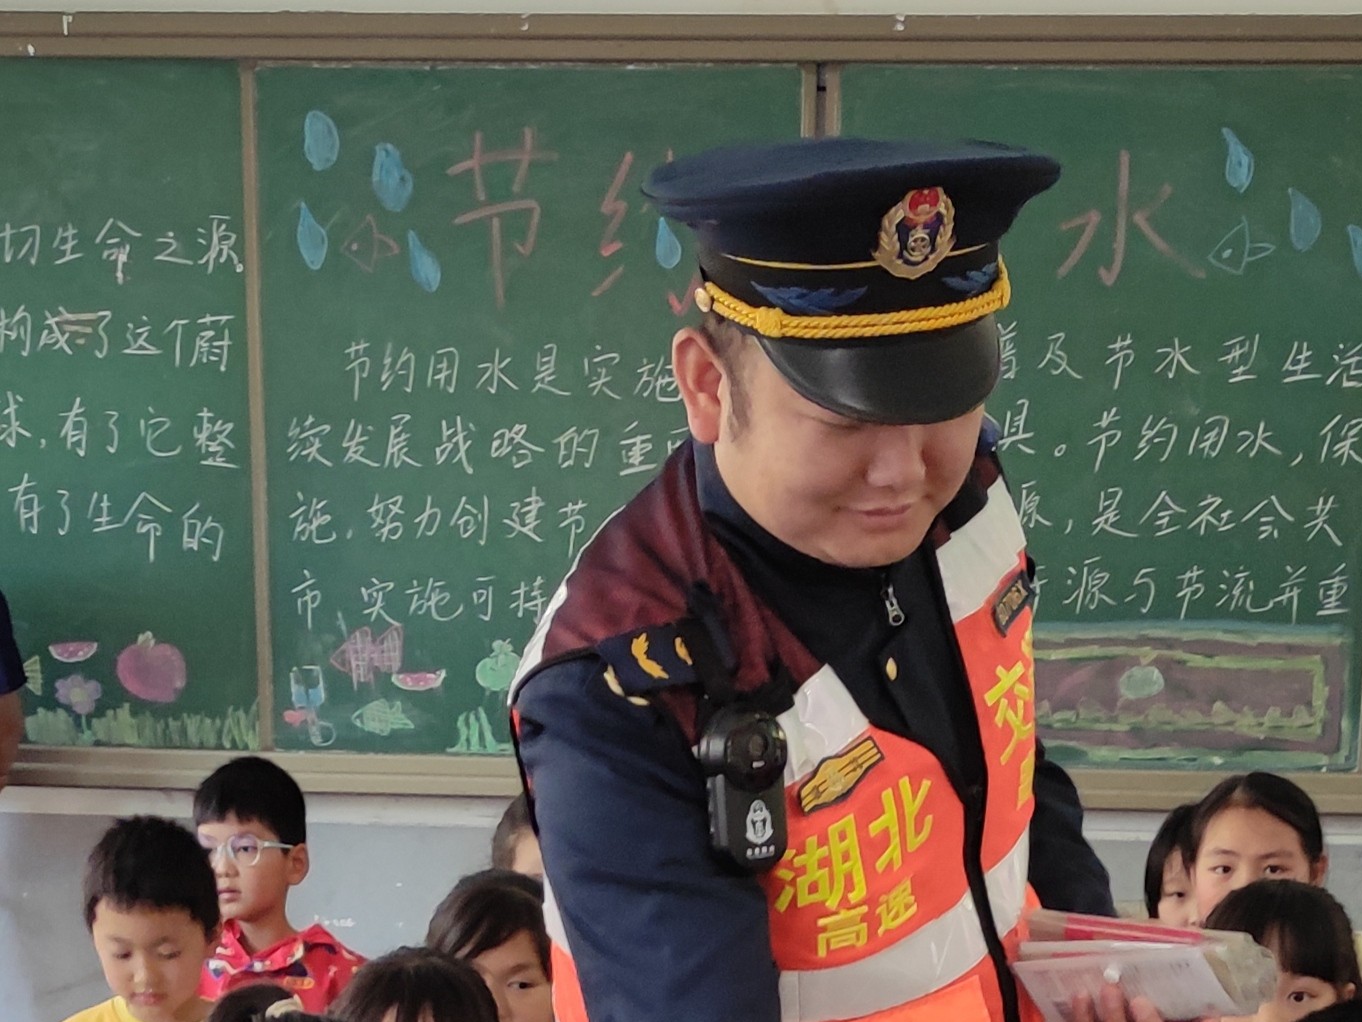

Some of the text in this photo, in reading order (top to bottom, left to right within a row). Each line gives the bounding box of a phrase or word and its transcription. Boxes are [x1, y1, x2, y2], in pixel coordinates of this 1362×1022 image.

[1057, 150, 1206, 286] 水
[344, 339, 685, 402] 节约用水是实施
[8, 473, 224, 563] 有了生命的
[774, 775, 932, 913] 湖北
[816, 880, 918, 959] 高速
